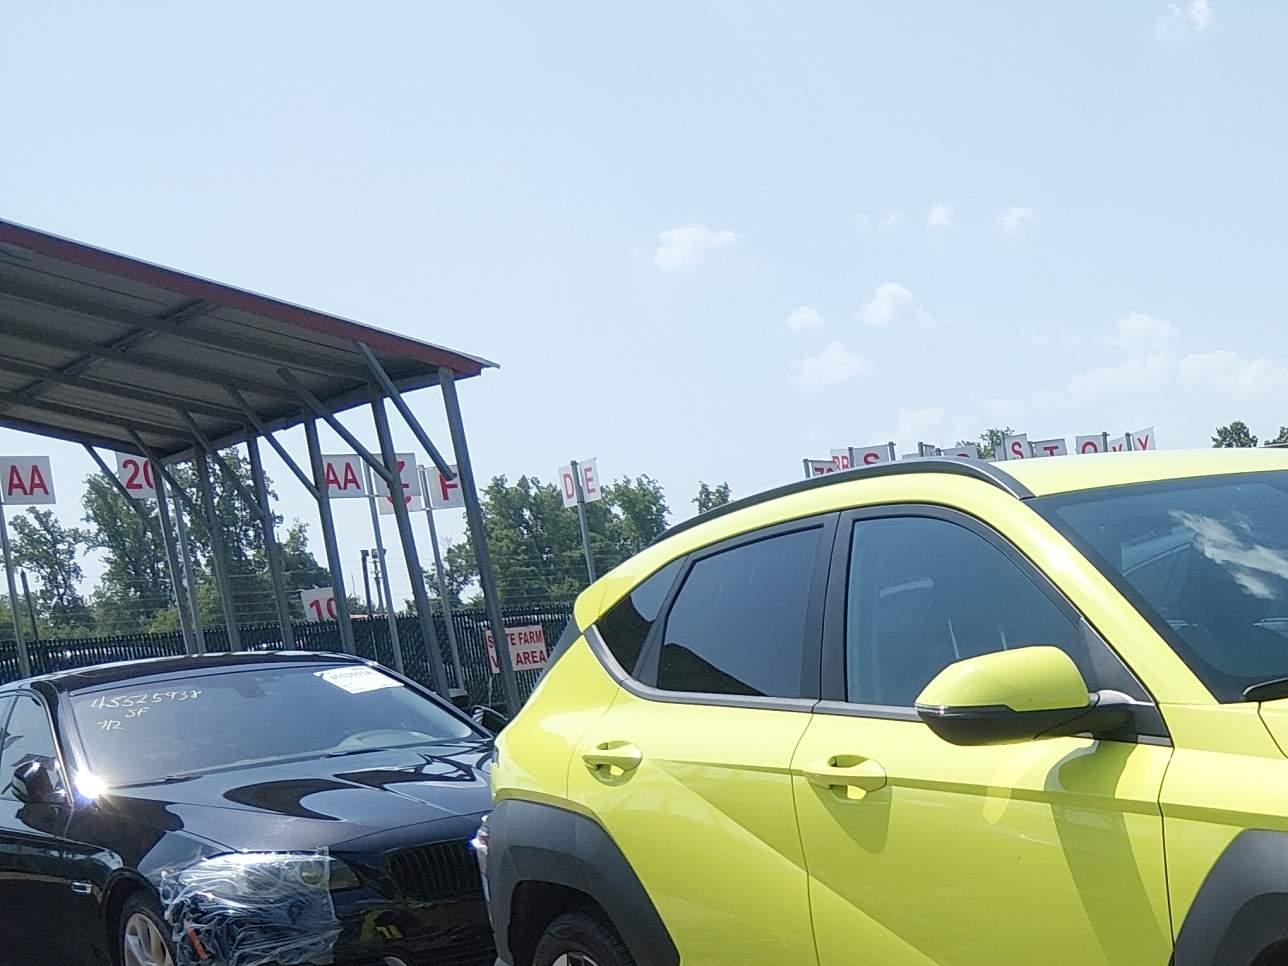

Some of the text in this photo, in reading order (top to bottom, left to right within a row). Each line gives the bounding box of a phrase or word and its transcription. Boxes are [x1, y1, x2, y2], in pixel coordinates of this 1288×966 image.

[7, 464, 49, 496] AA
[326, 462, 361, 491] AA
[517, 630, 544, 645] FARM
[515, 650, 548, 666] AREA
